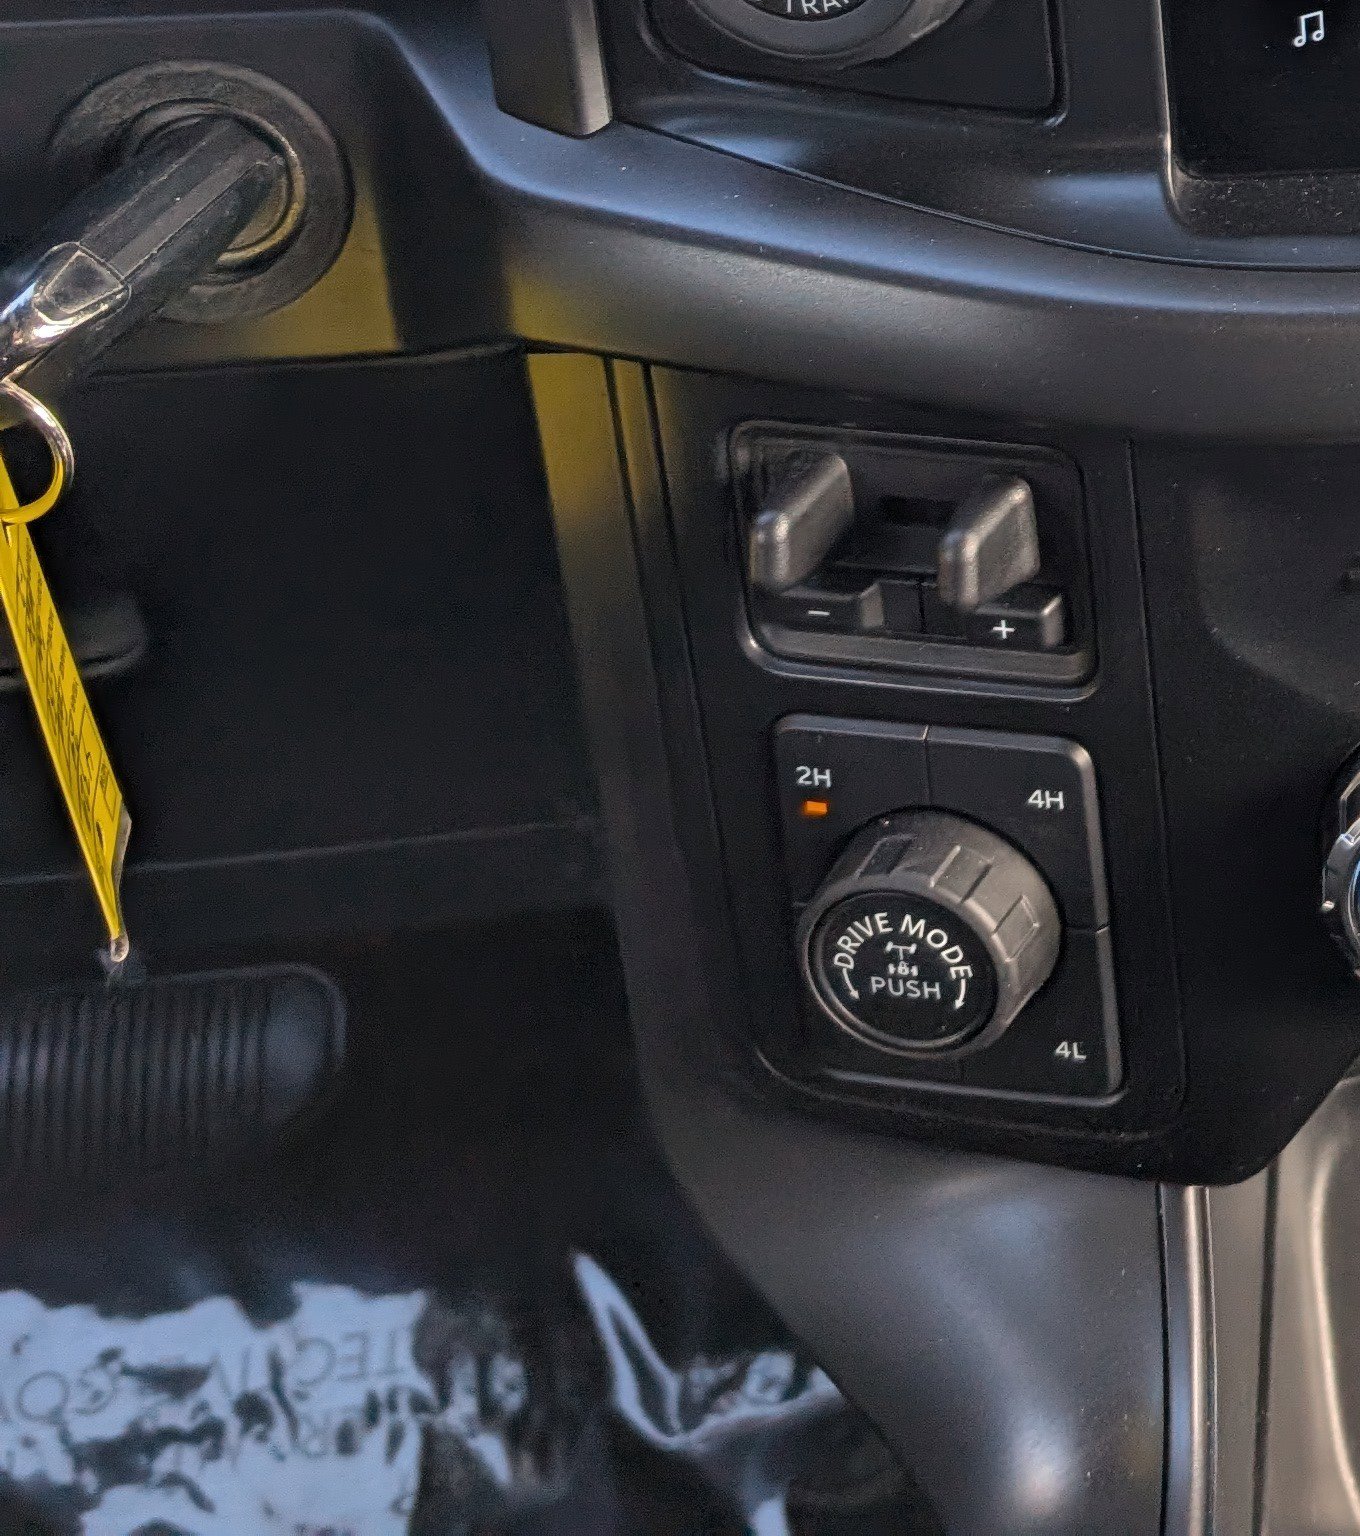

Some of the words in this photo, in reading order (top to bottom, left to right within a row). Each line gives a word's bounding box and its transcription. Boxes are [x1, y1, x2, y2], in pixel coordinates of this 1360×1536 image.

[795, 766, 832, 789] 2H
[1027, 789, 1065, 811] 4H
[833, 911, 894, 971] DRIVE
[900, 913, 974, 980] MODE
[870, 975, 942, 1001] PUSH
[1054, 1040, 1088, 1061] 4L
